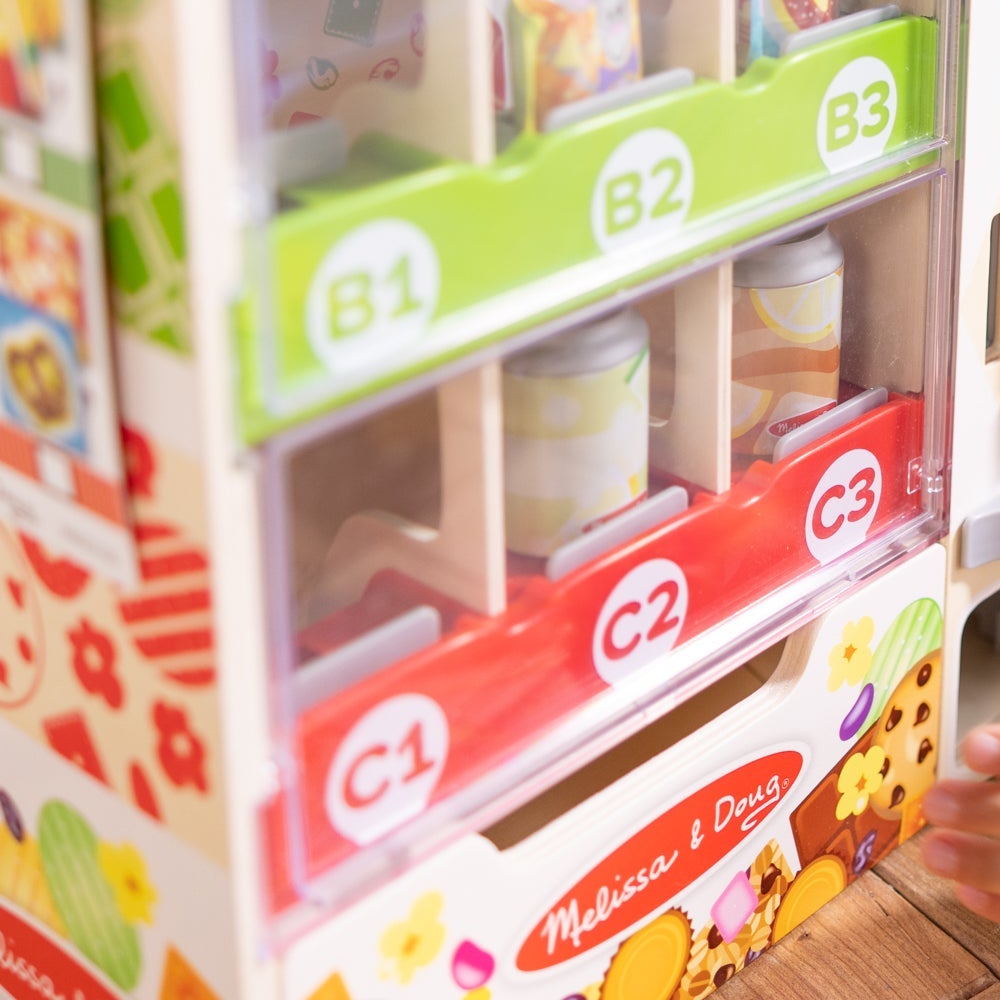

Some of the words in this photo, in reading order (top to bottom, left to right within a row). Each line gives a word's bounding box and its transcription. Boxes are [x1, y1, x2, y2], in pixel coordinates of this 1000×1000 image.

[825, 80, 892, 149] B3
[605, 159, 685, 236] B2
[327, 252, 424, 342] B1
[812, 467, 876, 541] C3
[602, 580, 681, 662] C2
[343, 722, 435, 808] C1
[541, 849, 679, 955] Melissa
[689, 819, 705, 850] &
[714, 774, 780, 831] Doug
